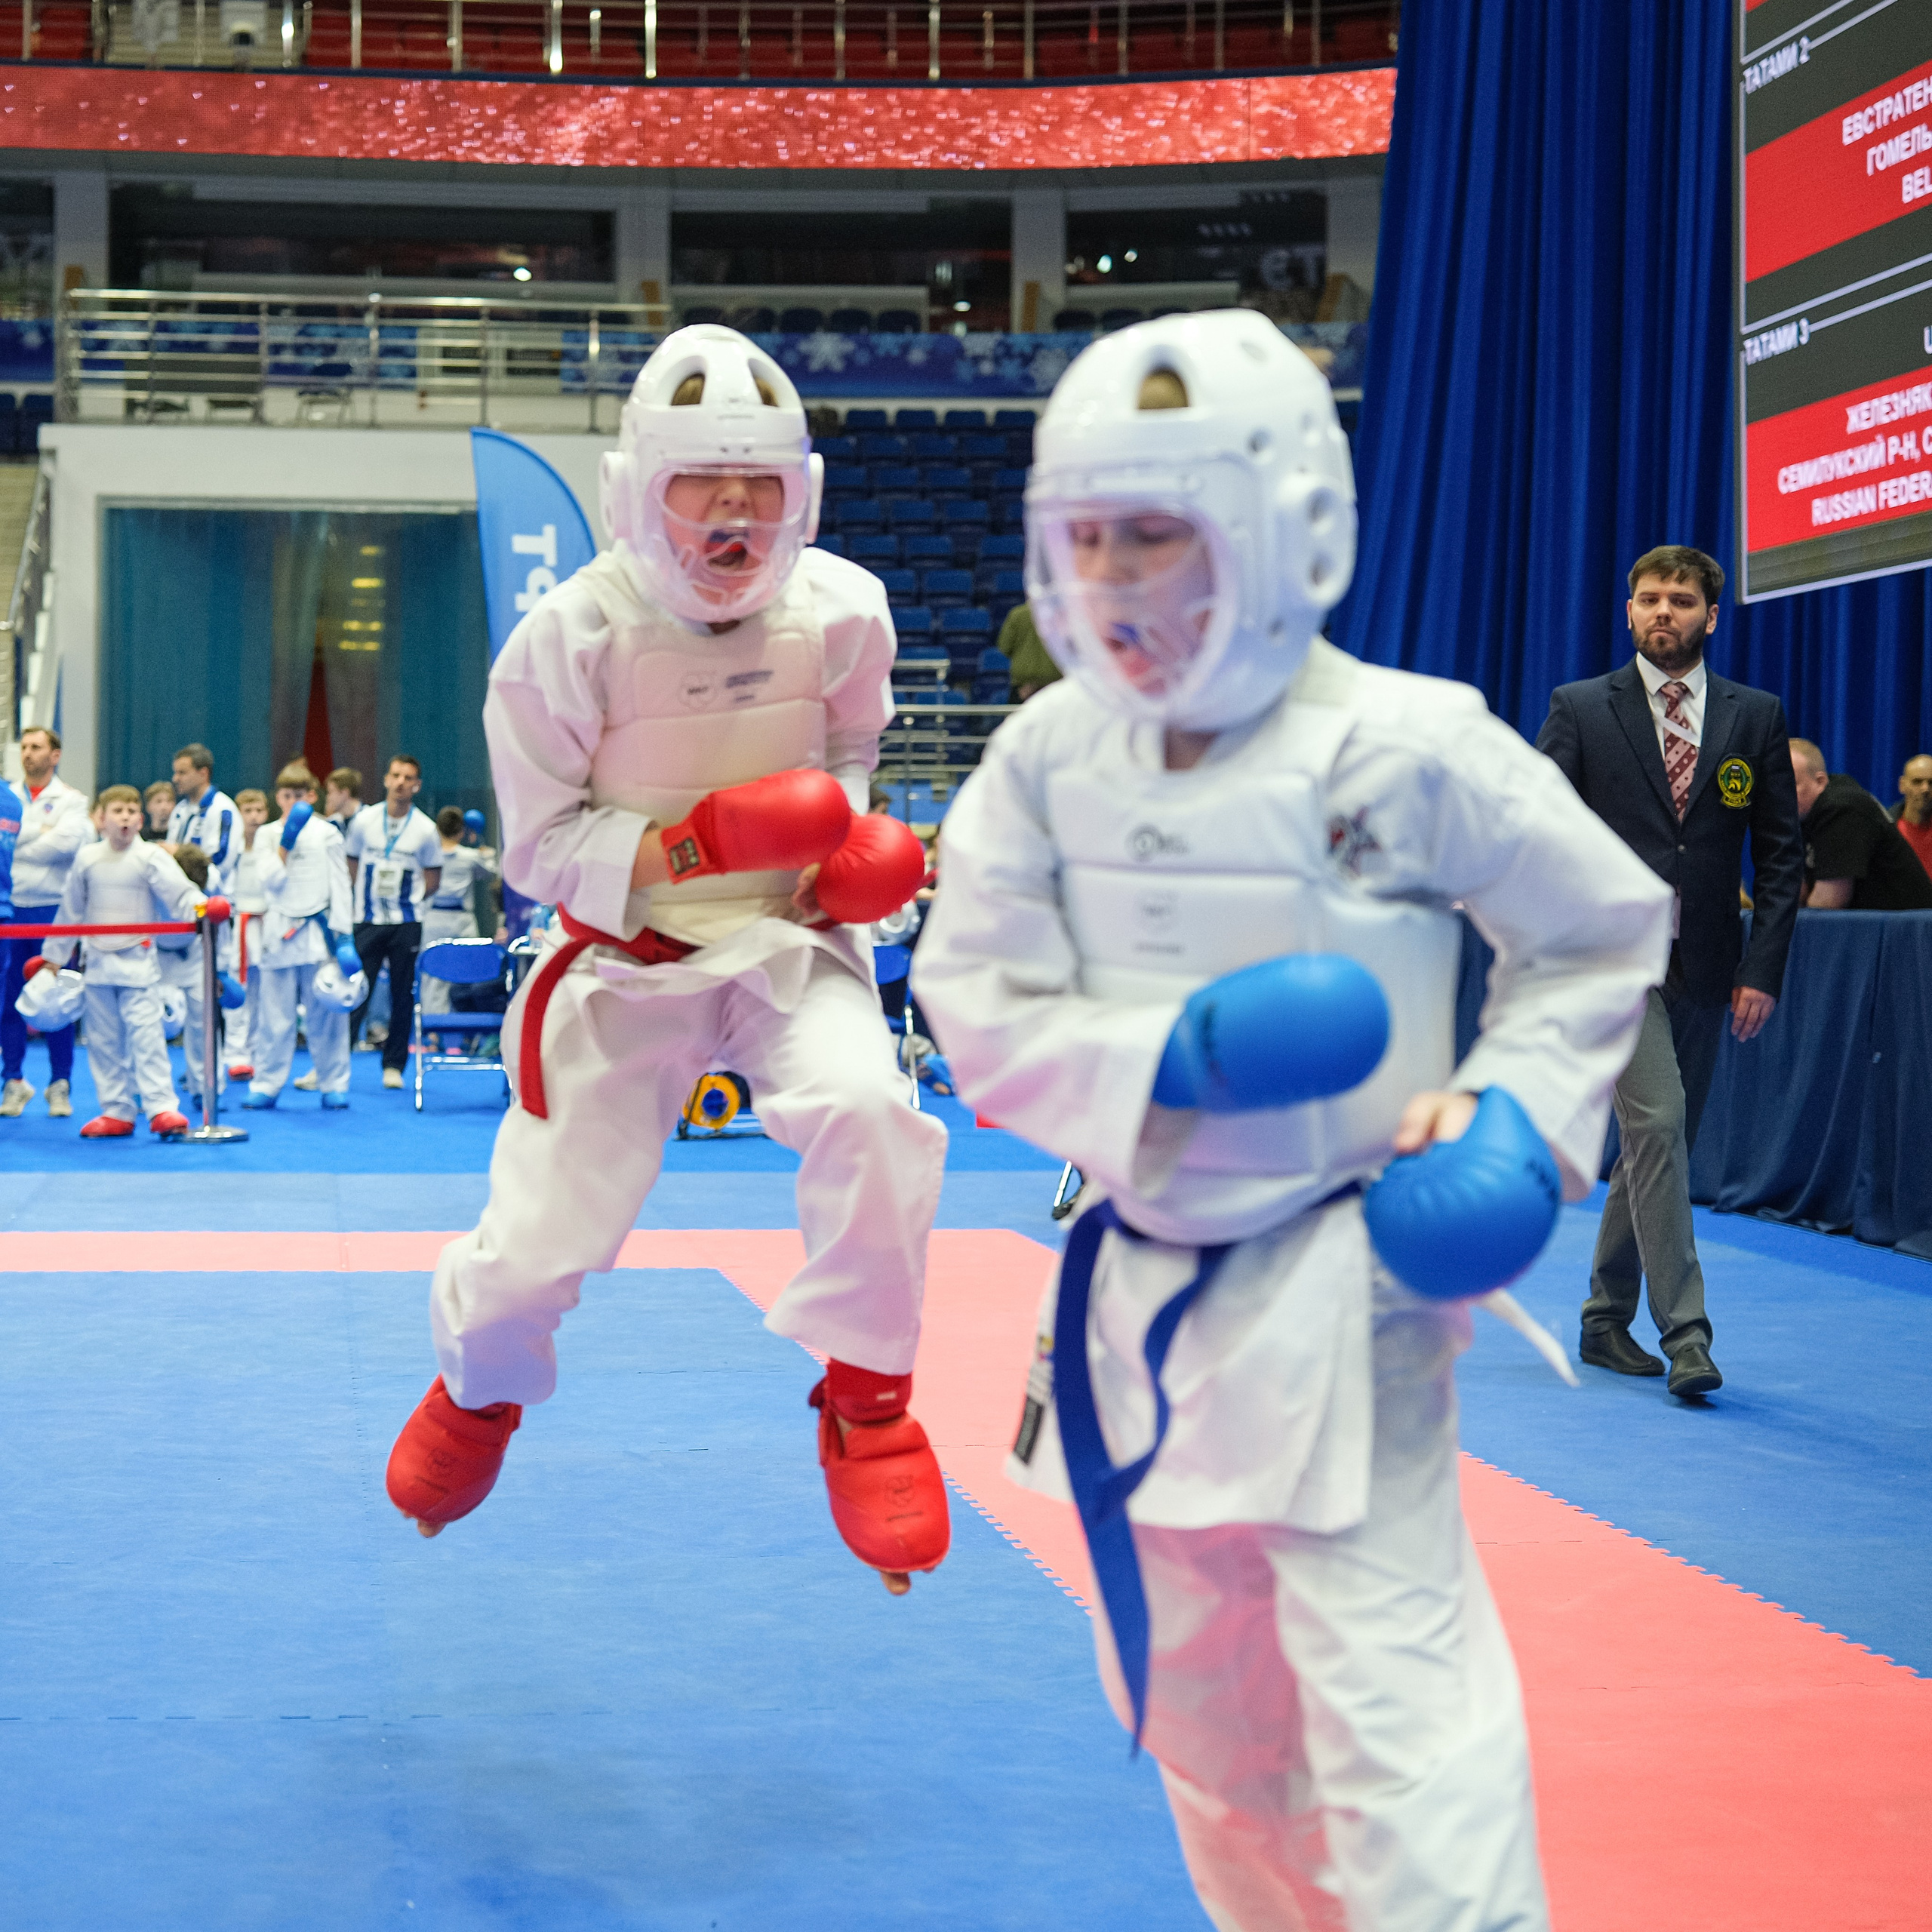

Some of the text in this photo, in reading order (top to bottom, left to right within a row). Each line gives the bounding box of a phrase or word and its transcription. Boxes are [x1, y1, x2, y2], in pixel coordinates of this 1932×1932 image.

[1799, 35, 1810, 64] 2
[1799, 318, 1810, 345] 3
[1812, 485, 1877, 527] RUSSIAN
